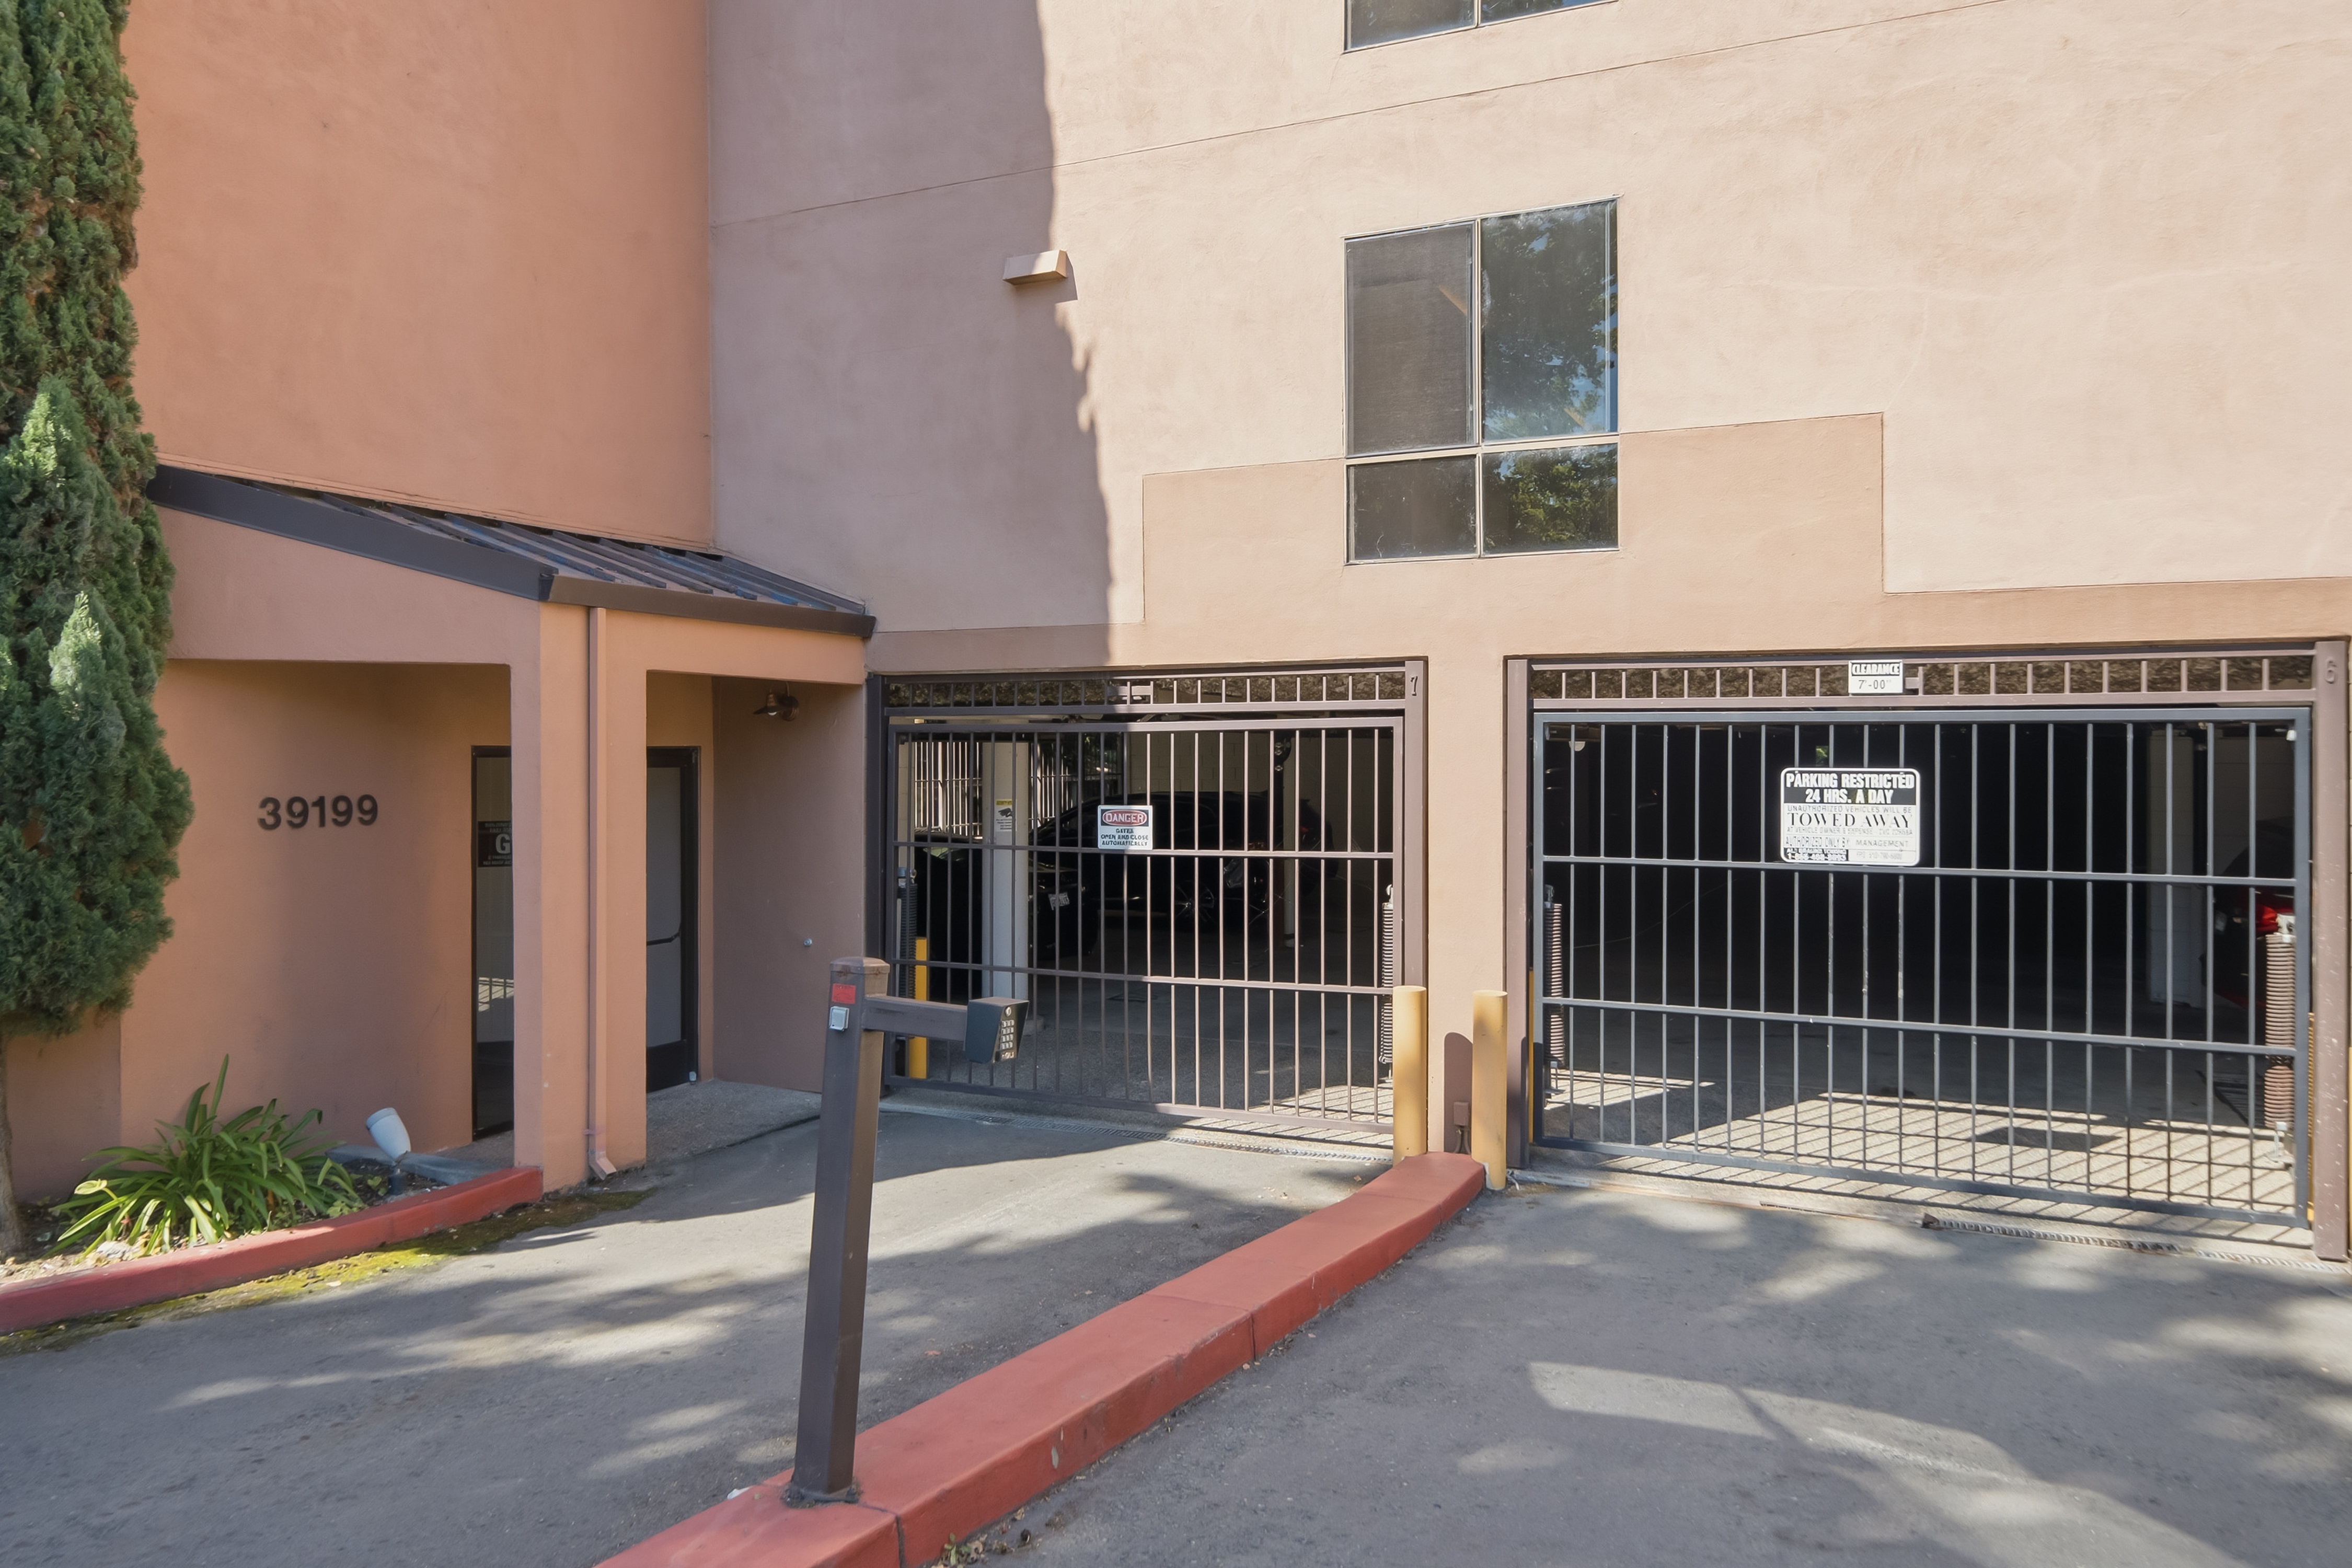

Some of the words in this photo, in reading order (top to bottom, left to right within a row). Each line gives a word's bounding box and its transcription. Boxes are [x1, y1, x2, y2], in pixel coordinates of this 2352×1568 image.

[1852, 663, 1900, 675] CLEARANCE
[1786, 773, 1838, 788] PARKING
[1841, 774, 1915, 789] RESTRICTED
[1805, 789, 1820, 803] 24
[1824, 789, 1852, 803] HRS.
[1855, 789, 1865, 803] A
[1868, 790, 1894, 804] DAY
[257, 794, 378, 830] 39199
[1106, 813, 1144, 822] DANGER
[1787, 813, 1855, 826] TOWED
[1861, 814, 1912, 828] AWAY
[495, 834, 511, 854] G
[1785, 836, 1822, 847] AUTHORIZED
[1825, 837, 1840, 847] ONLY
[1842, 837, 1850, 847] BY
